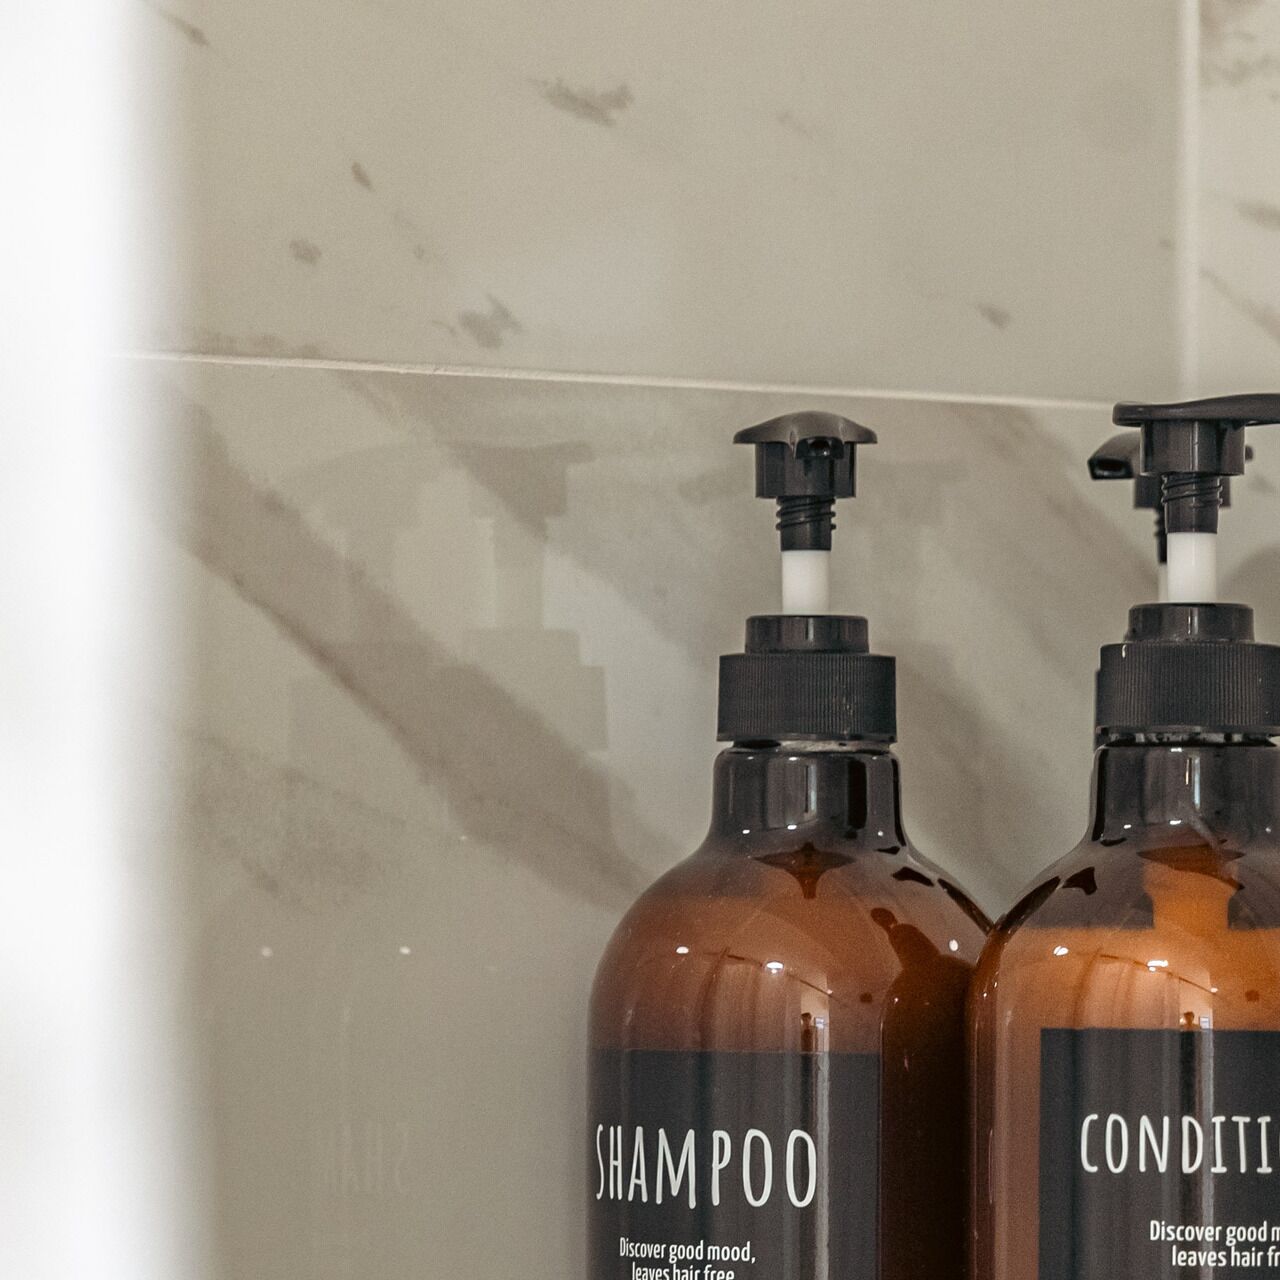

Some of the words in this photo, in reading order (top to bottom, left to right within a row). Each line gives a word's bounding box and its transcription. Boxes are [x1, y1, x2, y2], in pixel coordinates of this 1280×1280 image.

[596, 1124, 817, 1209] SHAMPOO
[1150, 1220, 1222, 1242] Discover
[1226, 1220, 1267, 1246] good
[620, 1237, 666, 1259] Discover
[669, 1240, 704, 1263] good
[707, 1241, 756, 1263] mood,
[1172, 1245, 1226, 1267] leaves
[1231, 1246, 1264, 1267] hair
